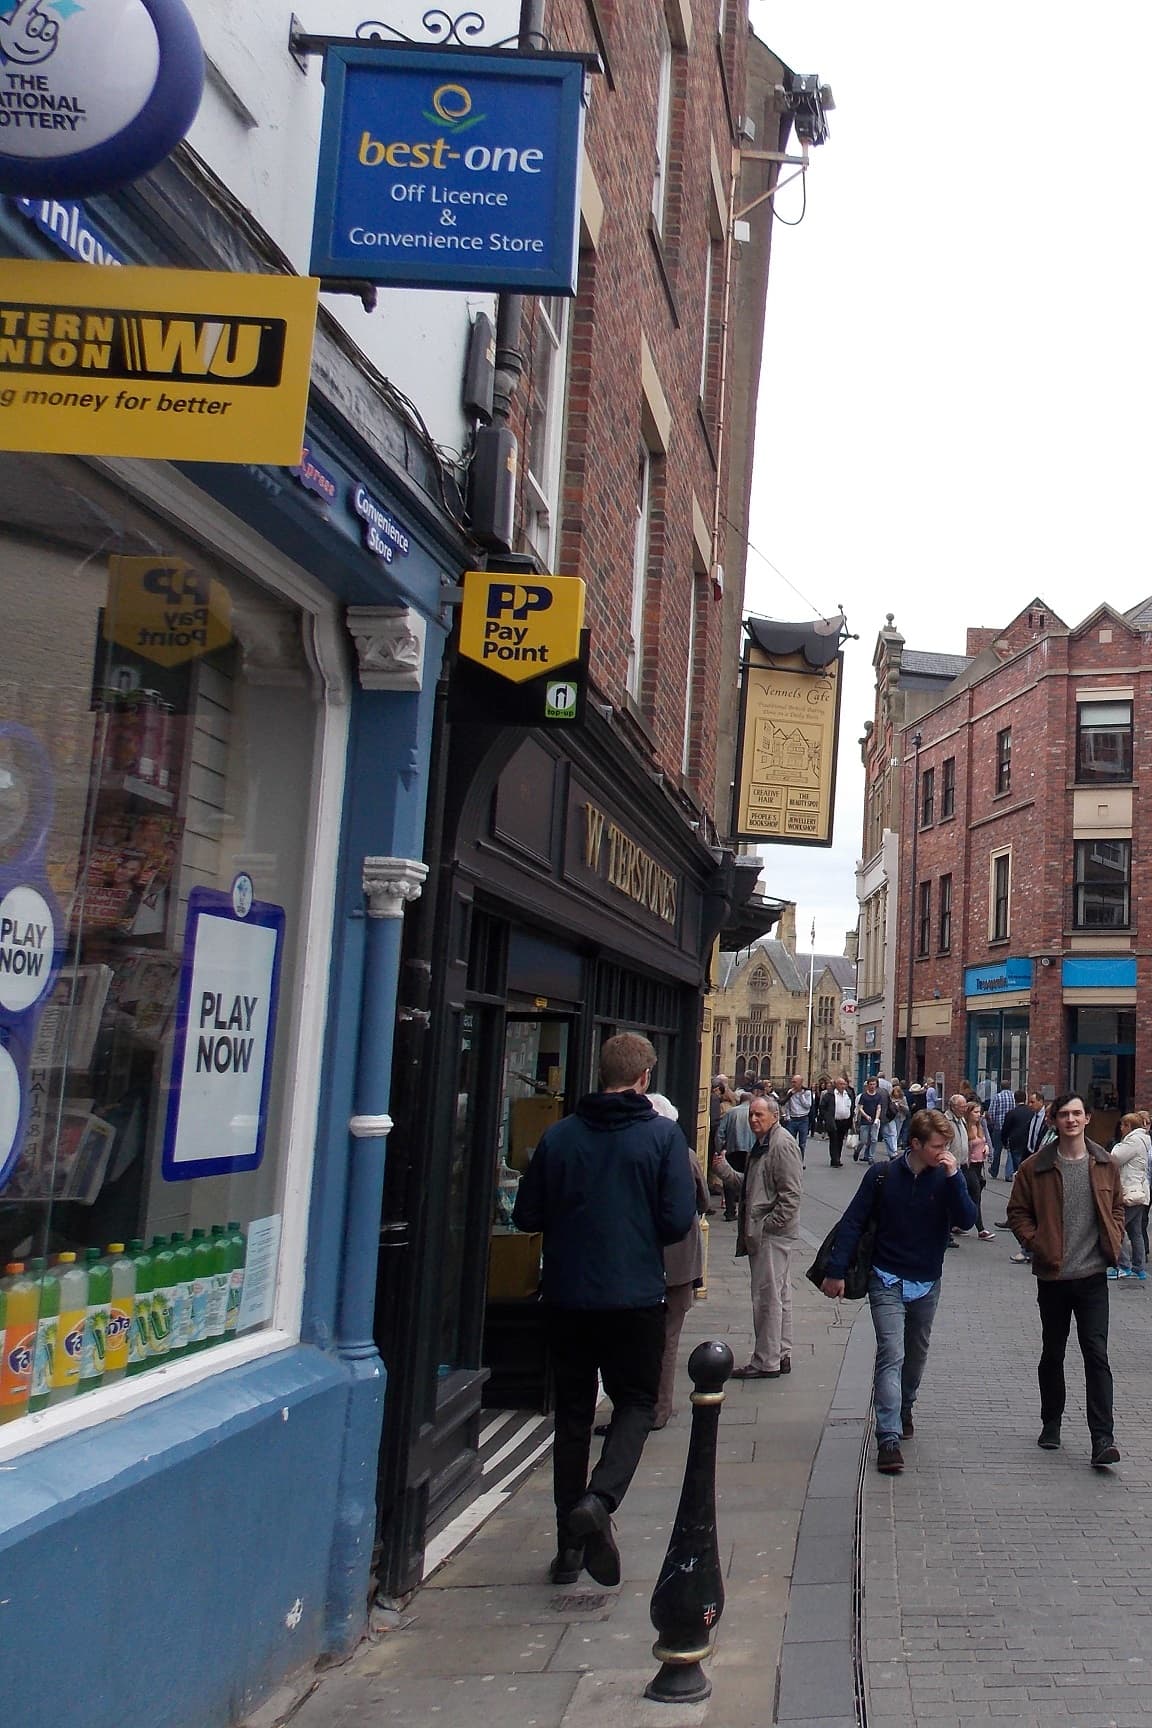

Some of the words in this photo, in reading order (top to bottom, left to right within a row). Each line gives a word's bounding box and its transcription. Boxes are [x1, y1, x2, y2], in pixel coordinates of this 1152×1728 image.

[5, 73, 49, 92] THE
[358, 131, 545, 174] best-one
[390, 184, 426, 202] Off
[431, 186, 509, 207] Licence
[439, 208, 457, 226] &
[349, 227, 484, 250] Convenience
[489, 233, 545, 252] Store
[0, 310, 114, 342] TERN
[140, 318, 263, 378] WU
[23, 388, 109, 412] money
[114, 390, 152, 412] for
[156, 392, 233, 415] better
[356, 488, 410, 553] Convenience
[369, 526, 393, 563] Store
[485, 621, 529, 646] Pay
[482, 641, 550, 663] Point
[754, 682, 801, 699] Vennels
[547, 709, 575, 718] top-up
[753, 788, 780, 797] CREATIVE
[749, 819, 779, 827] BOOKSHOP
[787, 823, 816, 832] WORKSHOP
[1, 918, 48, 949] PLAY
[0, 948, 43, 977] NOW
[199, 991, 259, 1032] PLAY
[196, 1035, 255, 1074] NOW
